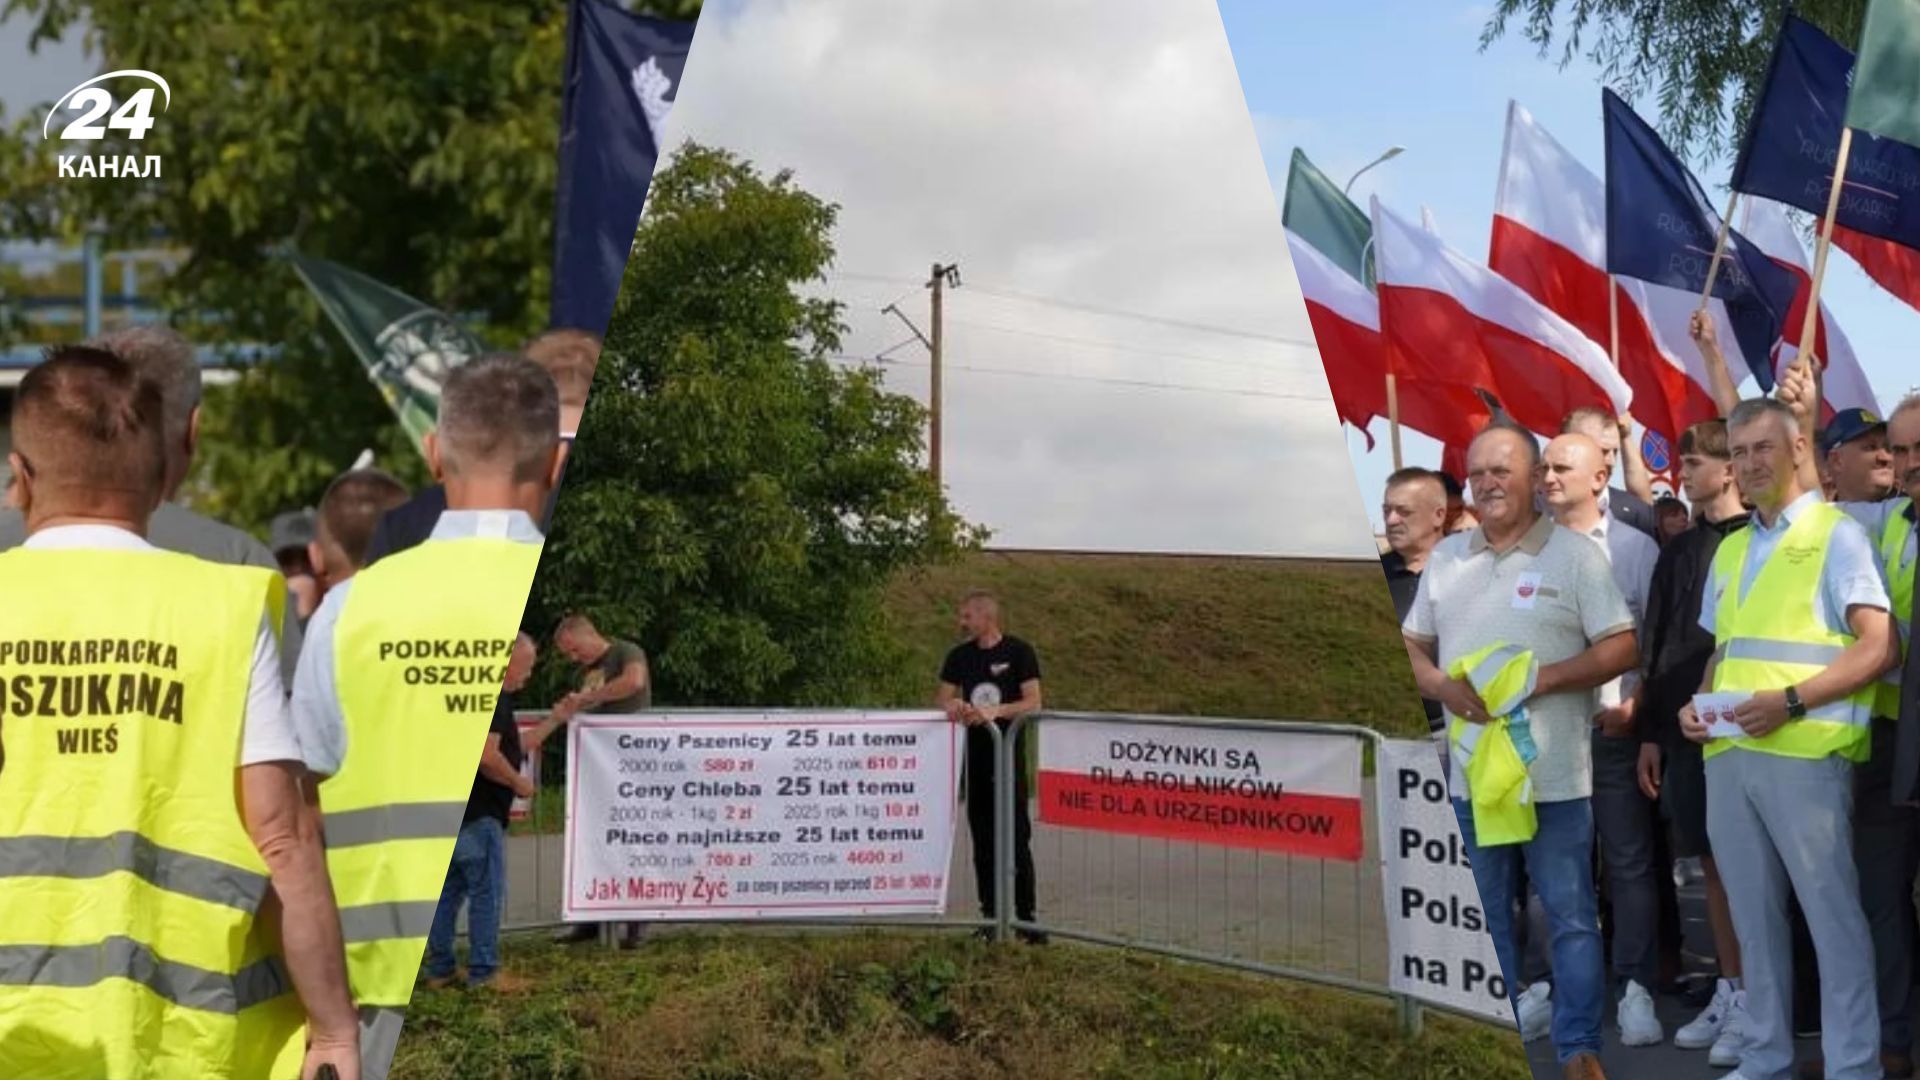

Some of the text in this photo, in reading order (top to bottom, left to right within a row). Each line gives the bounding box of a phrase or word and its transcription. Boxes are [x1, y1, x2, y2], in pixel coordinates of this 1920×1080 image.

[0, 638, 178, 670] PODKARPACKA
[445, 693, 501, 713] WIE
[57, 722, 118, 754] WIEŚ
[617, 729, 917, 755] Ceny Pszenicy 25 lat temu
[661, 758, 686, 772] rok
[837, 757, 863, 771] rok
[1110, 739, 1260, 776] DOŻYNKI SĄ
[617, 776, 915, 800] Ceny Chleba 25 lat temu
[1091, 765, 1136, 787] DLA
[1398, 767, 1453, 804] Po
[724, 805, 736, 819] 2
[1058, 789, 1094, 811] NIE
[1101, 793, 1147, 817] DLA
[795, 826, 823, 843] 25
[831, 827, 859, 841] lat
[867, 827, 924, 841] temu
[586, 878, 622, 900] Jak
[627, 877, 686, 903] Mamy
[1402, 886, 1491, 934] Pols
[1404, 954, 1448, 986] na
